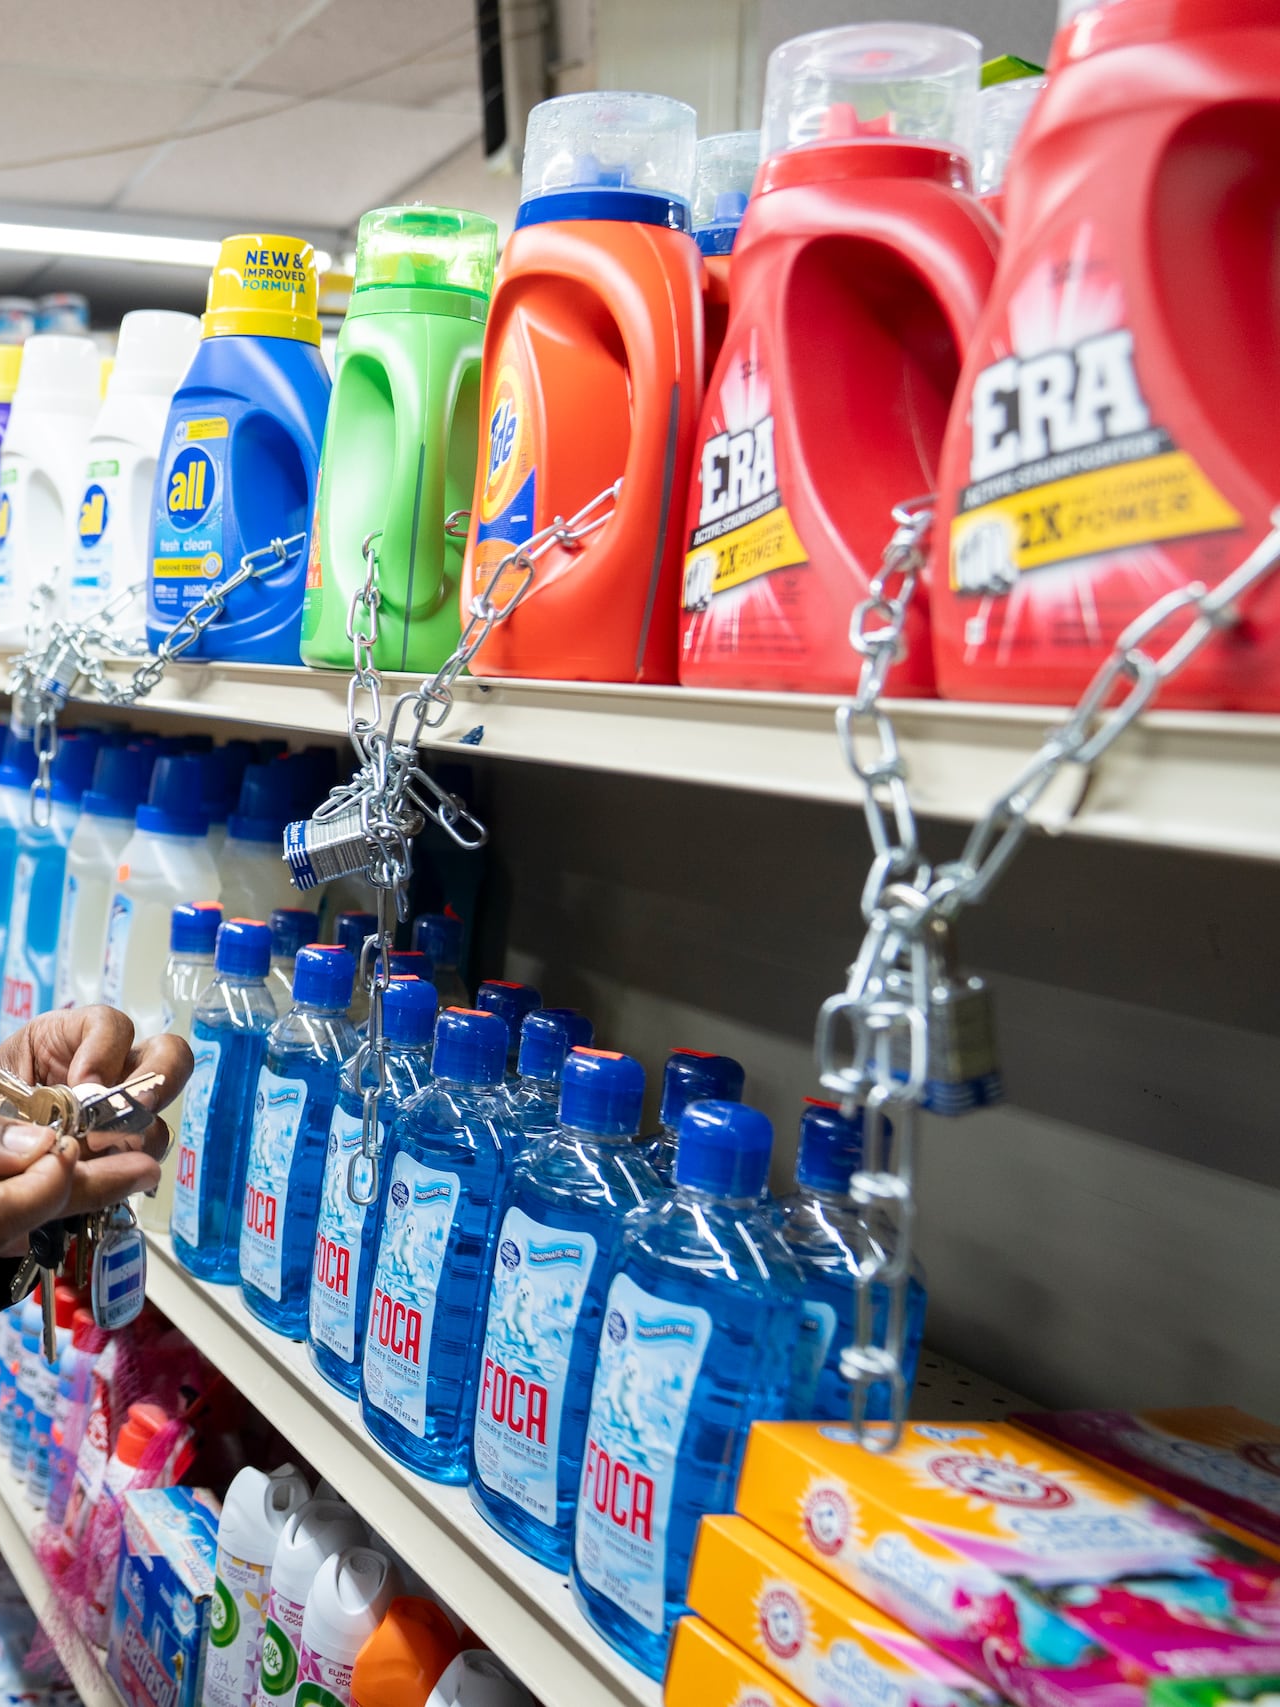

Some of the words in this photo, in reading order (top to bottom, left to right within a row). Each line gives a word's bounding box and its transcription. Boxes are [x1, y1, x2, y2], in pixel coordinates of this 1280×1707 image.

[244, 268, 306, 281] IMPROVED
[246, 250, 289, 267] NEW
[292, 253, 303, 269] &
[242, 279, 305, 294] FORMULA
[970, 327, 1150, 482] ERA
[485, 398, 518, 498] Tide
[699, 415, 777, 526] ERA
[168, 460, 206, 513] all
[183, 536, 213, 552] clean
[313, 1231, 350, 1298] FOCA
[369, 1288, 423, 1366] FOCA
[387, 1355, 421, 1379] Detergent
[479, 1357, 549, 1447] FOCA
[503, 1433, 549, 1461] Detergent
[582, 1437, 655, 1544] FOCA
[283, 1615, 303, 1628] ODOR
